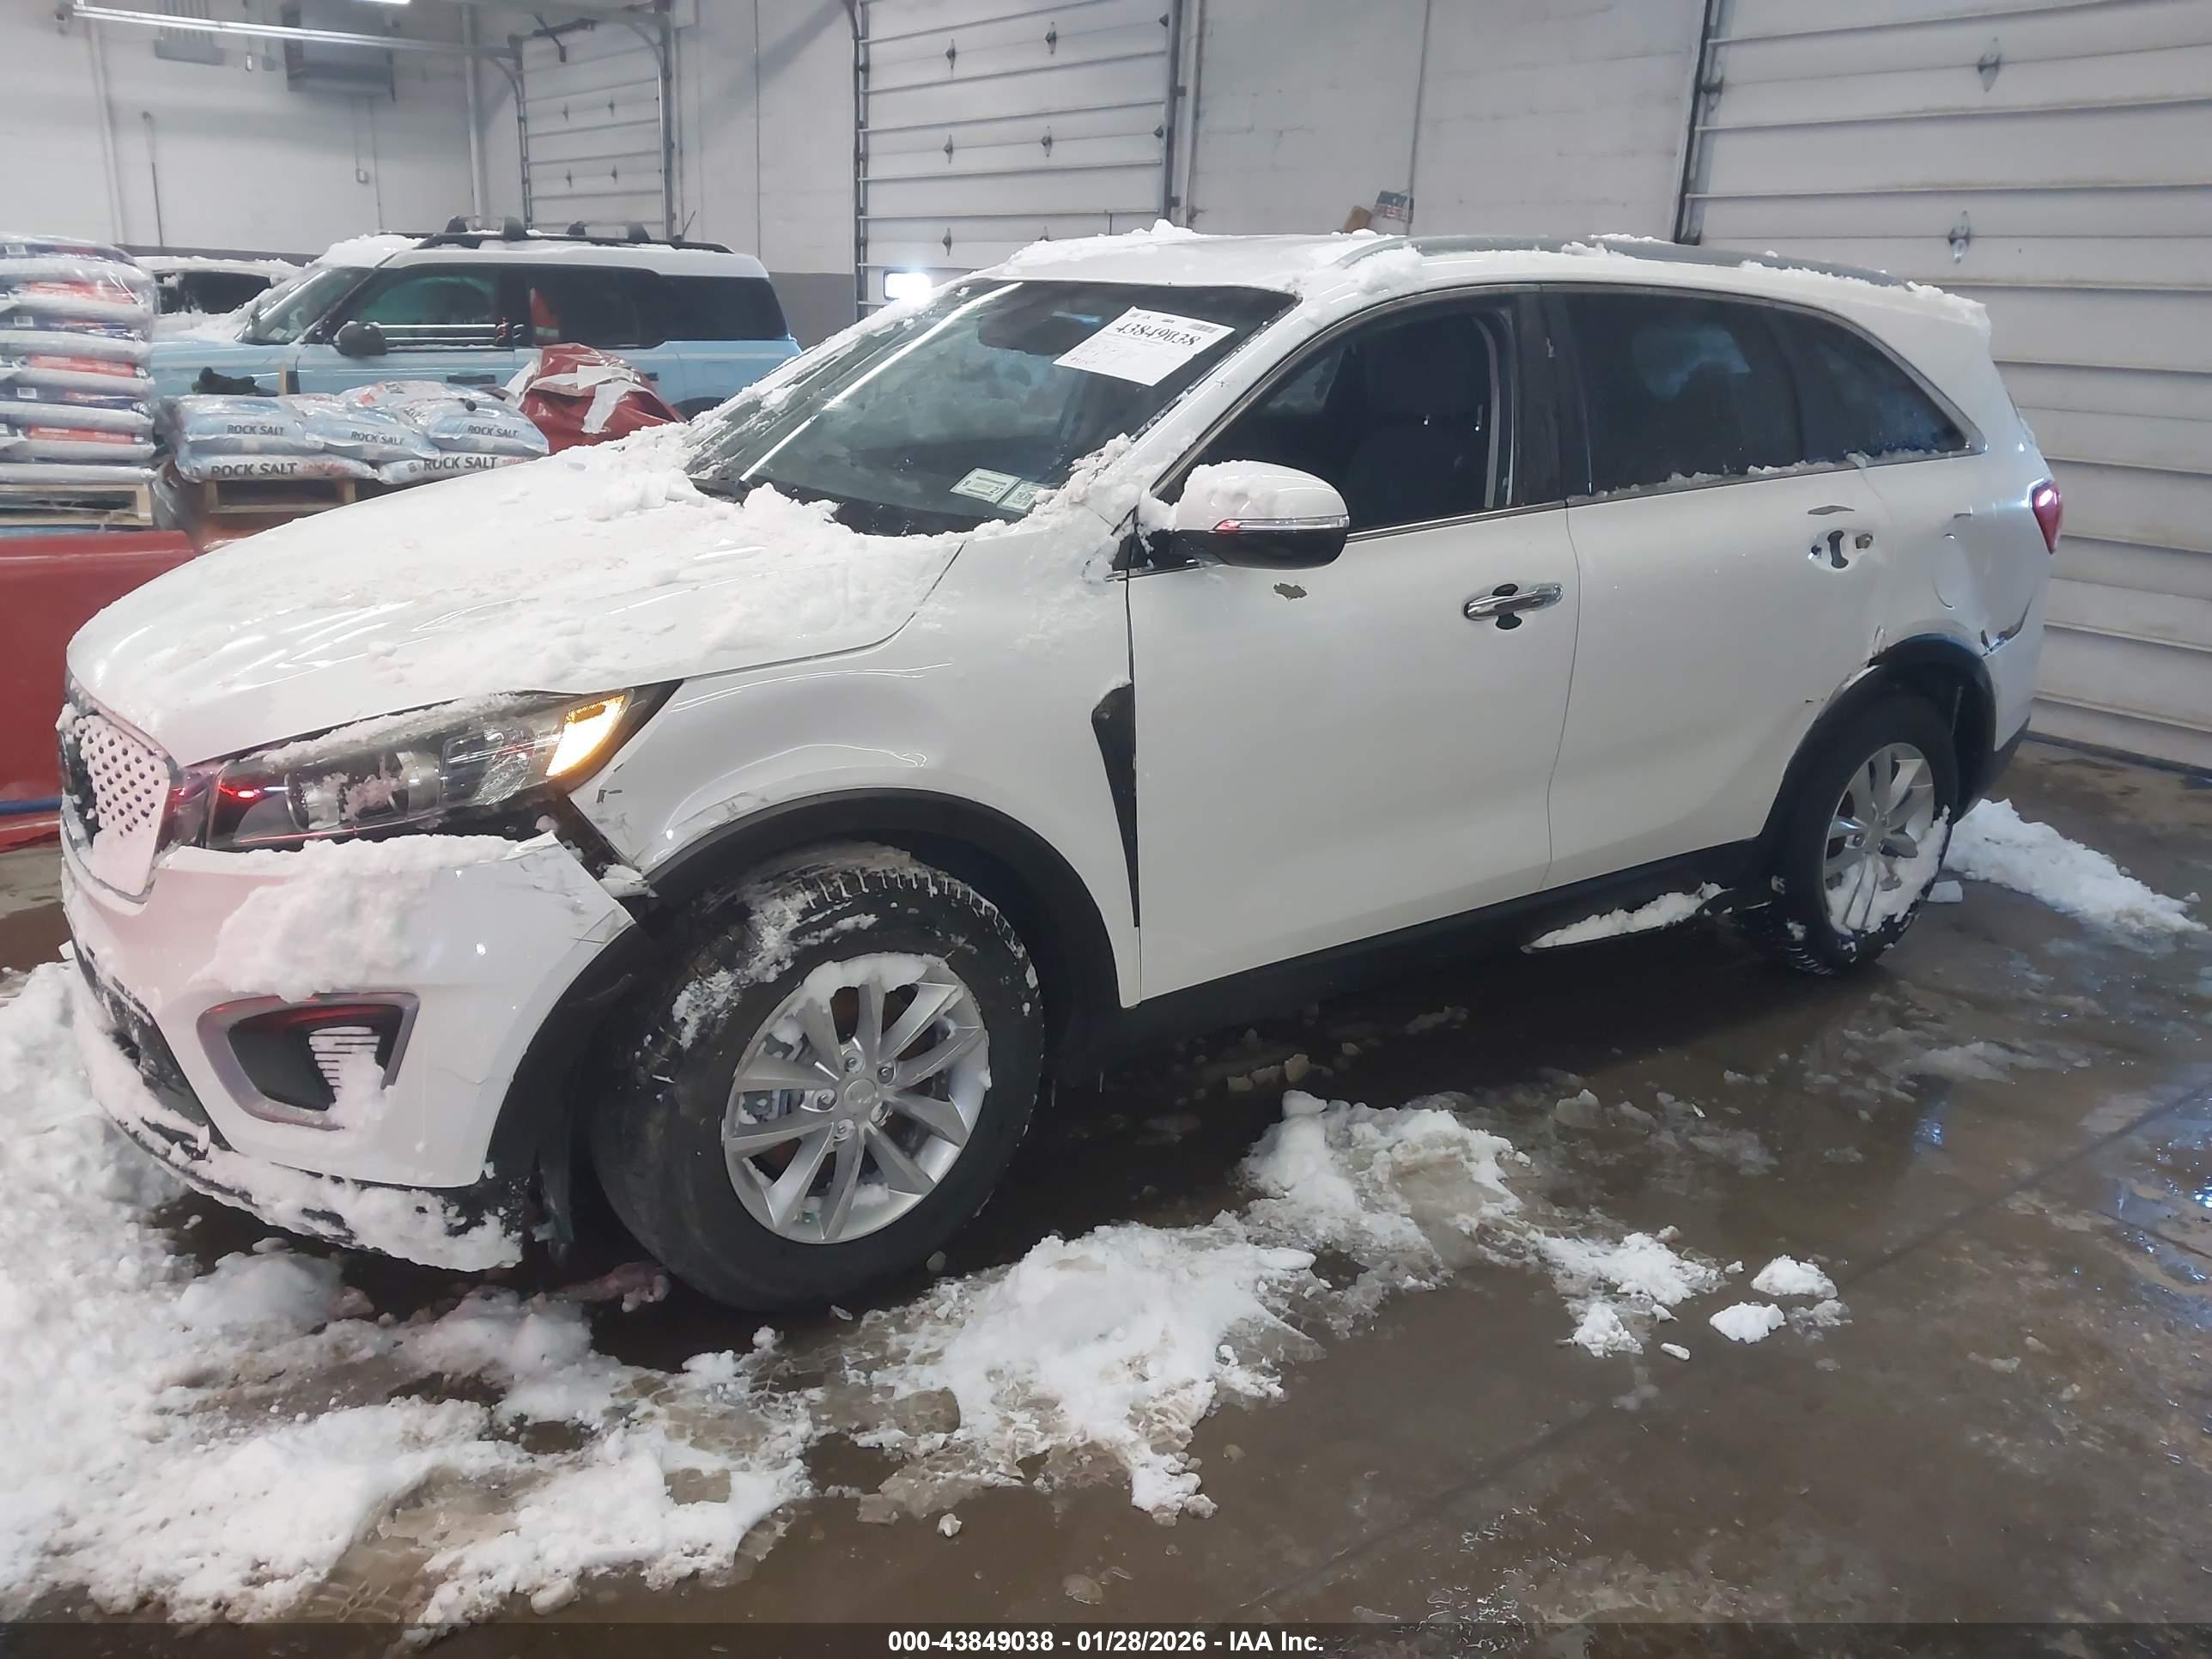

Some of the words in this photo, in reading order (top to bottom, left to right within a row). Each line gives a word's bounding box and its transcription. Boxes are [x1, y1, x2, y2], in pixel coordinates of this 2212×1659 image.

[227, 424, 257, 434] ROCK
[259, 425, 285, 436] SALT
[467, 424, 495, 436] ROCK
[495, 428, 519, 438] SALT
[350, 431, 379, 442] ROCK
[380, 434, 405, 447] SALT
[210, 463, 255, 477] ROCK
[258, 462, 298, 476] SALT
[423, 456, 460, 471] ROCK
[464, 456, 498, 470] SALT
